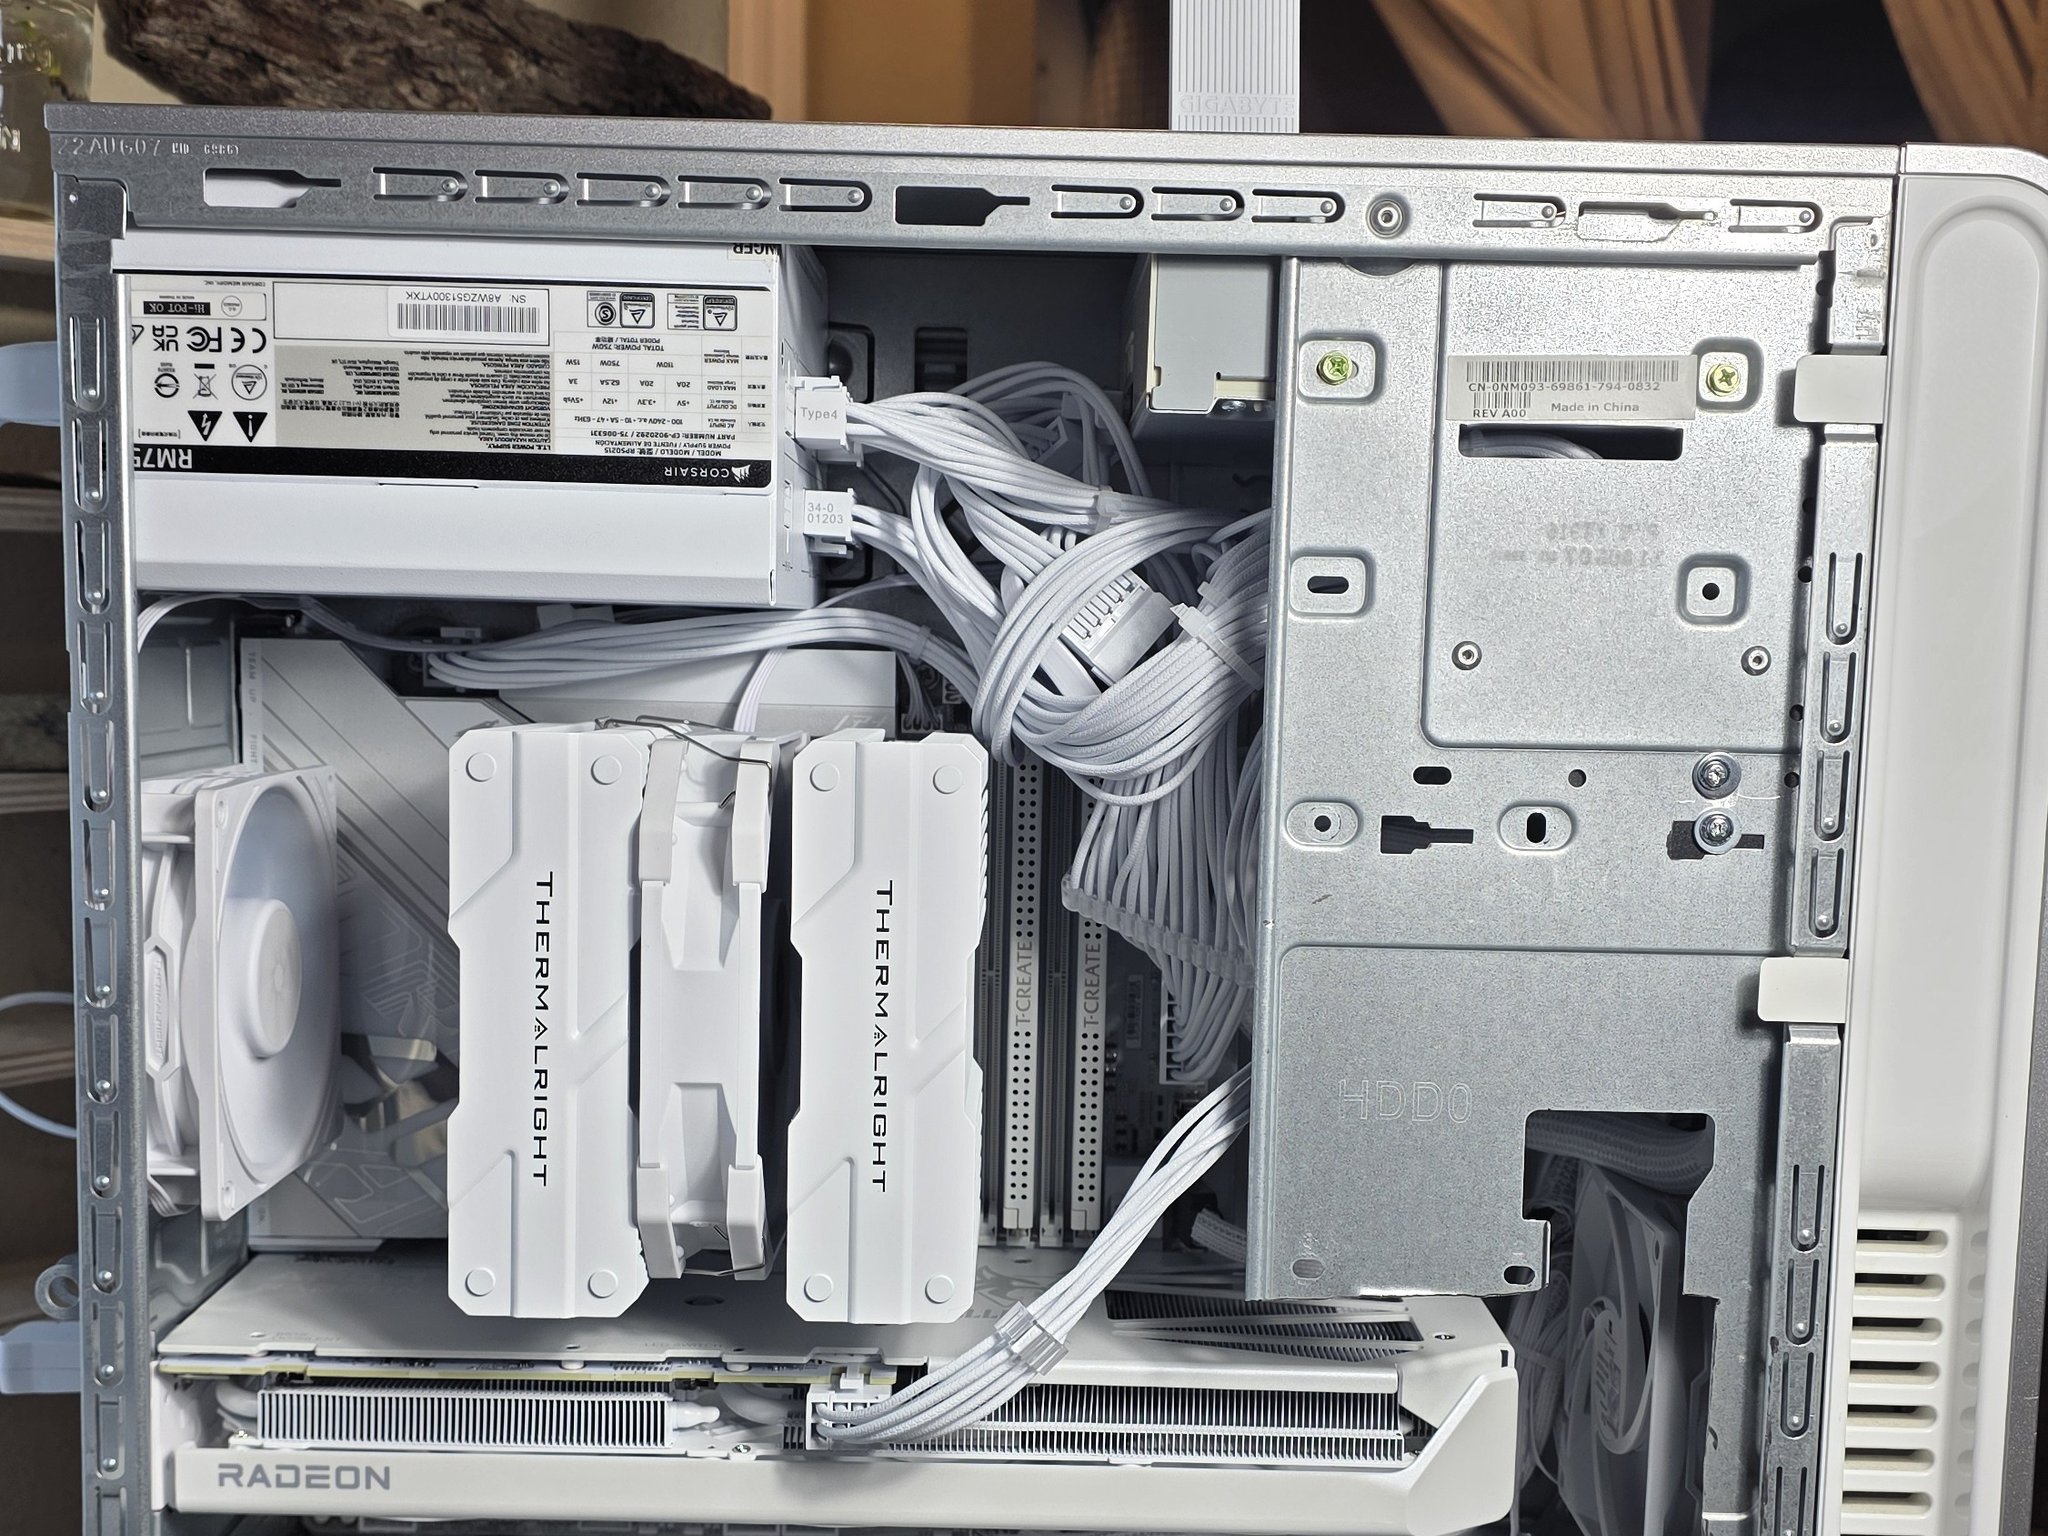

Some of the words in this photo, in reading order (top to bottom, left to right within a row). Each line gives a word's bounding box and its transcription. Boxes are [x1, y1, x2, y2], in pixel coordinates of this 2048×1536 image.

[1179, 94, 1295, 116] GIGABYTE
[148, 303, 164, 313] OK
[169, 303, 205, 314] Hi-POT
[231, 327, 267, 354] CE
[613, 343, 641, 351] POWER:
[1472, 408, 1497, 418] REV
[1501, 408, 1526, 418] A00
[1550, 402, 1584, 413] Made
[1587, 402, 1599, 412] in
[1602, 402, 1640, 413] China
[800, 406, 838, 421] Type4
[682, 432, 716, 440] NUMBER:
[664, 467, 729, 478] CORSAIR
[807, 502, 834, 513] 34-0
[807, 513, 844, 525] 01203
[533, 871, 554, 1187] THERMALRIGHT
[872, 880, 894, 1193] THERMALRIGHT
[217, 1462, 391, 1490] RADEON
